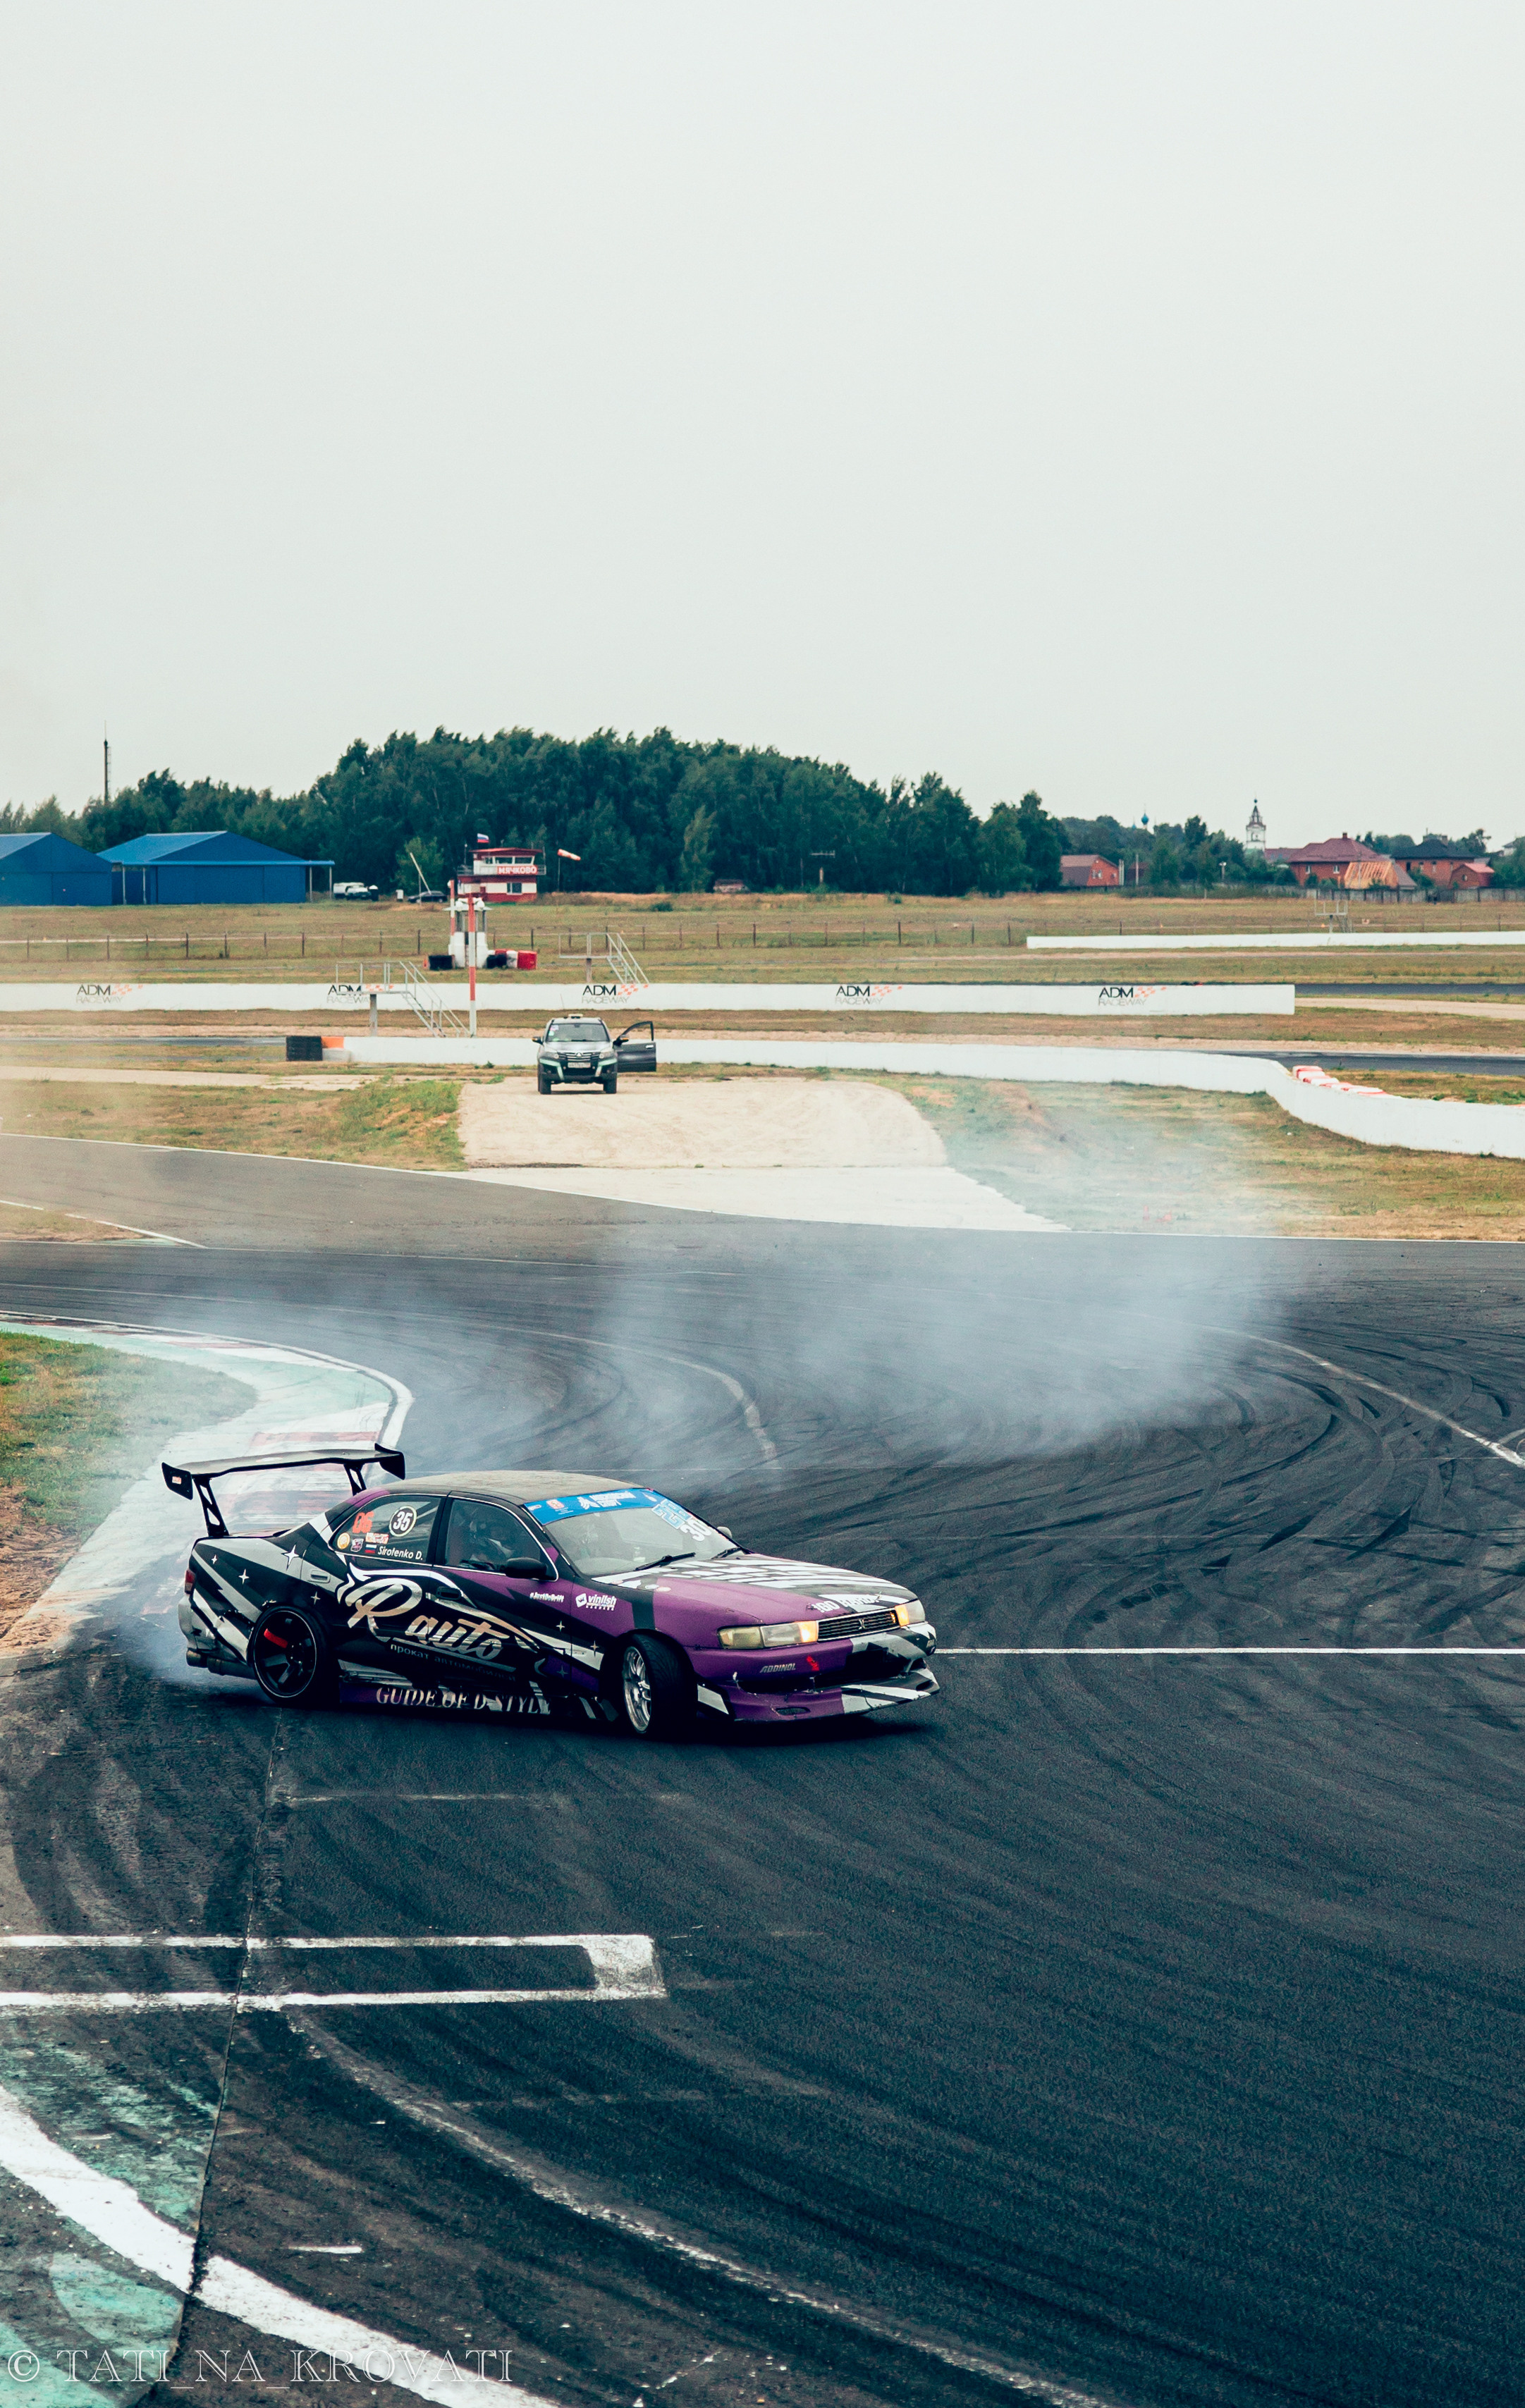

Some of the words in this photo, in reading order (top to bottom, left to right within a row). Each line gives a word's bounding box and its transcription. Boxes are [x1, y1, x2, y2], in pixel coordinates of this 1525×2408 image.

[498, 866, 537, 874] МЯЧКОВО
[77, 985, 111, 995] ADM
[328, 985, 362, 996] ADM
[583, 985, 616, 996] ADM
[836, 985, 870, 997] ADM
[1099, 988, 1133, 998] ADM
[393, 1511, 413, 1531] 35
[680, 1519, 712, 1542] 30
[378, 1546, 414, 1559] Sirotenko
[415, 1551, 423, 1560] D.
[391, 1644, 429, 1659] прокат
[759, 1663, 796, 1673] ADDINOL
[376, 1686, 437, 1707] GUIDE
